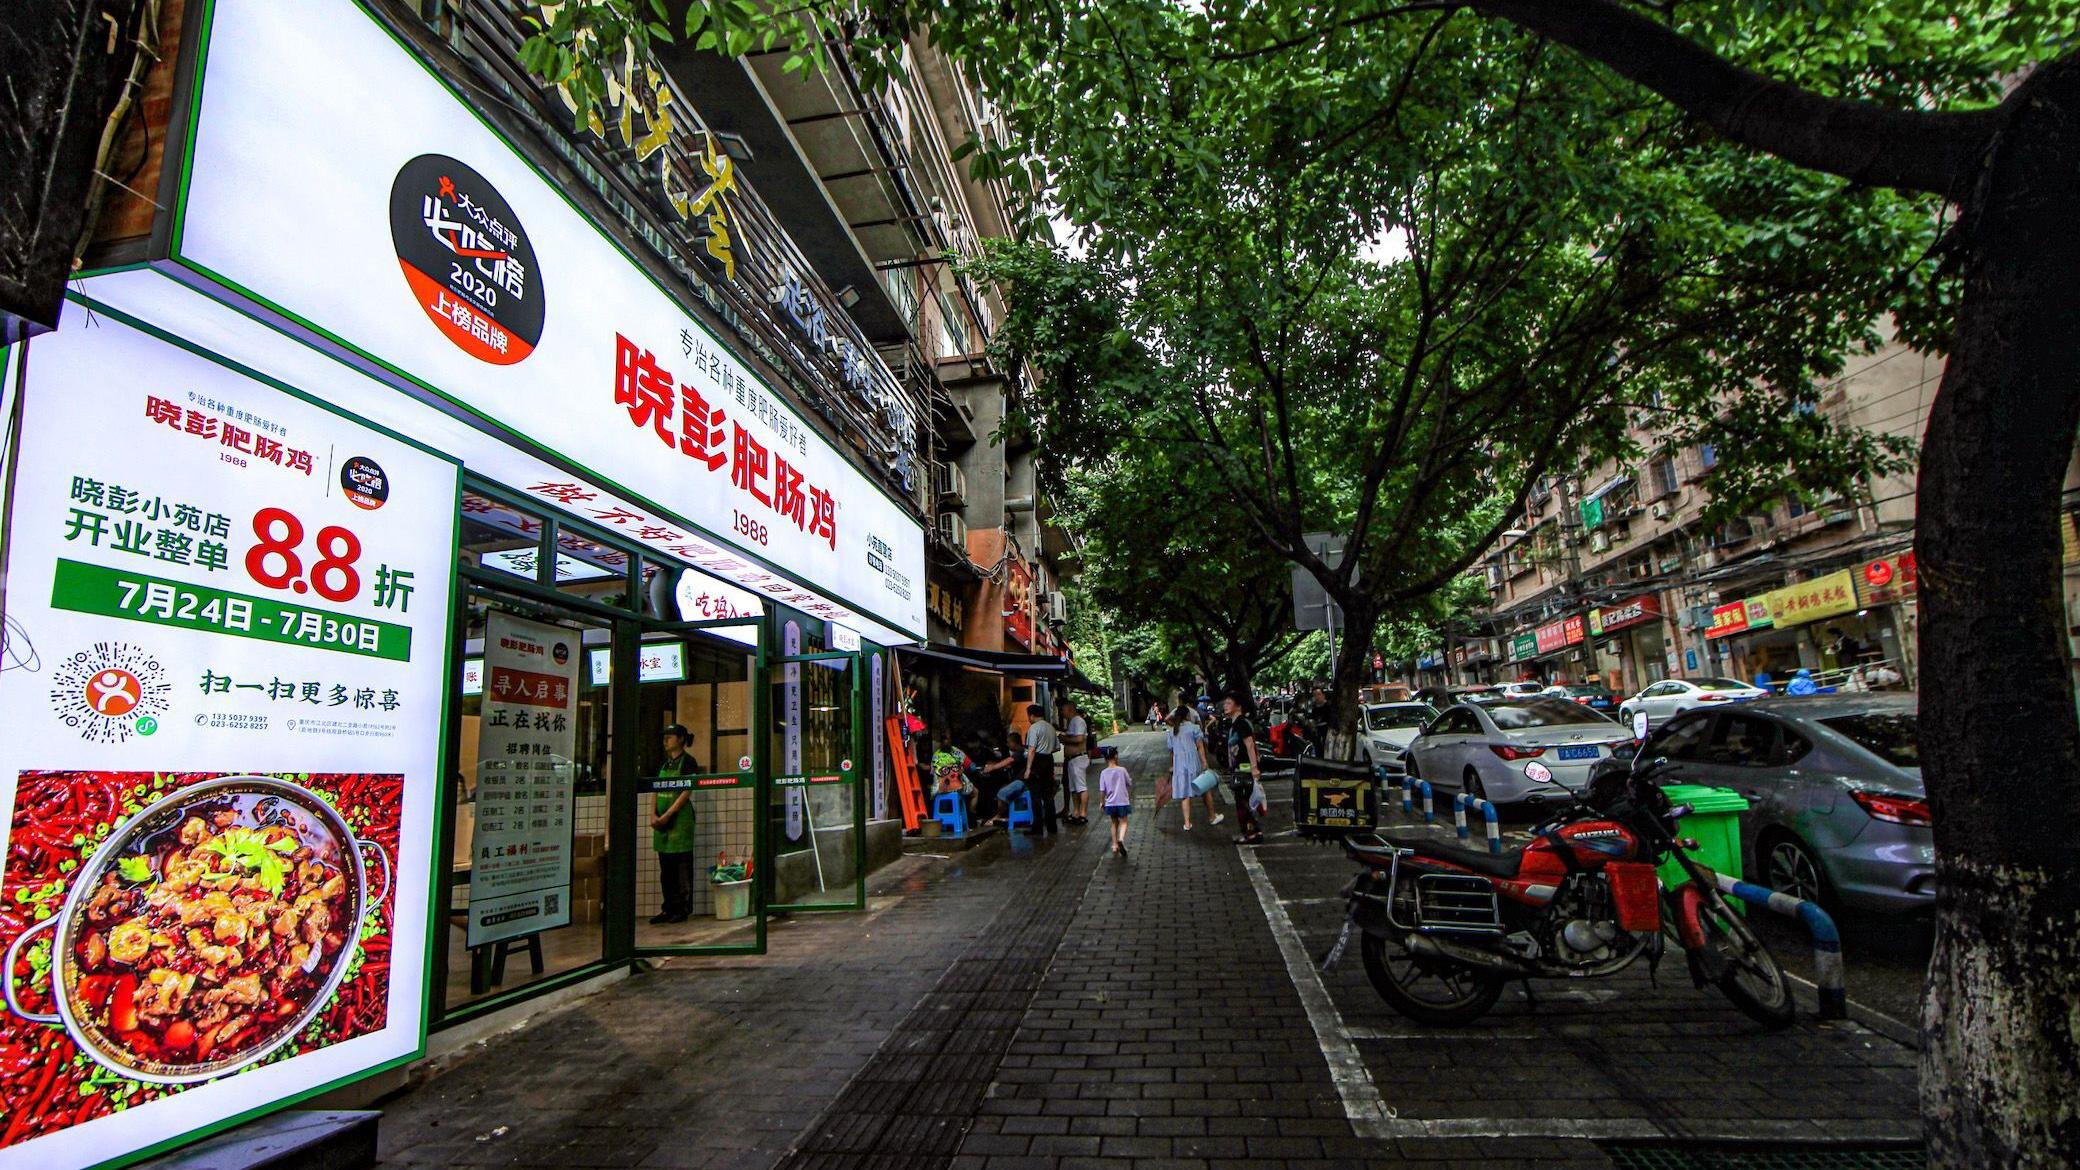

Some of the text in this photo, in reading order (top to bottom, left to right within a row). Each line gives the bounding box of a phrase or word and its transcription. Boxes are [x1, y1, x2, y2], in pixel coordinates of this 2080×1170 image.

[457, 192, 518, 251] 大众点评
[423, 194, 525, 300] 必吃榜
[450, 262, 497, 307] 2020
[430, 290, 508, 355] 上榜品牌
[187, 391, 287, 437] 专治各种重度肥肠爱好者
[680, 327, 807, 458] 专治各种重度肥肠爱好者
[145, 395, 313, 476] 晓彭肥肠鸡
[614, 331, 837, 552] 晓彭肥肠鸡
[218, 452, 247, 468] 1988
[70, 476, 231, 539] 晓彭小苑店
[357, 484, 372, 494] 2020
[64, 508, 228, 572] 开业整单
[732, 508, 768, 546] 1988
[244, 507, 415, 613] 8.8 折
[200, 668, 402, 712] 扫一扫更多惊喜
[496, 675, 566, 701] 寻人启事
[210, 720, 268, 730] 023-6252 8257
[228, 714, 248, 722] 5037
[489, 709, 566, 732] 正在找你
[506, 743, 552, 756] 招聘岗位
[482, 842, 528, 859] 员工福利
[1574, 830, 1620, 840] SUZUKI
